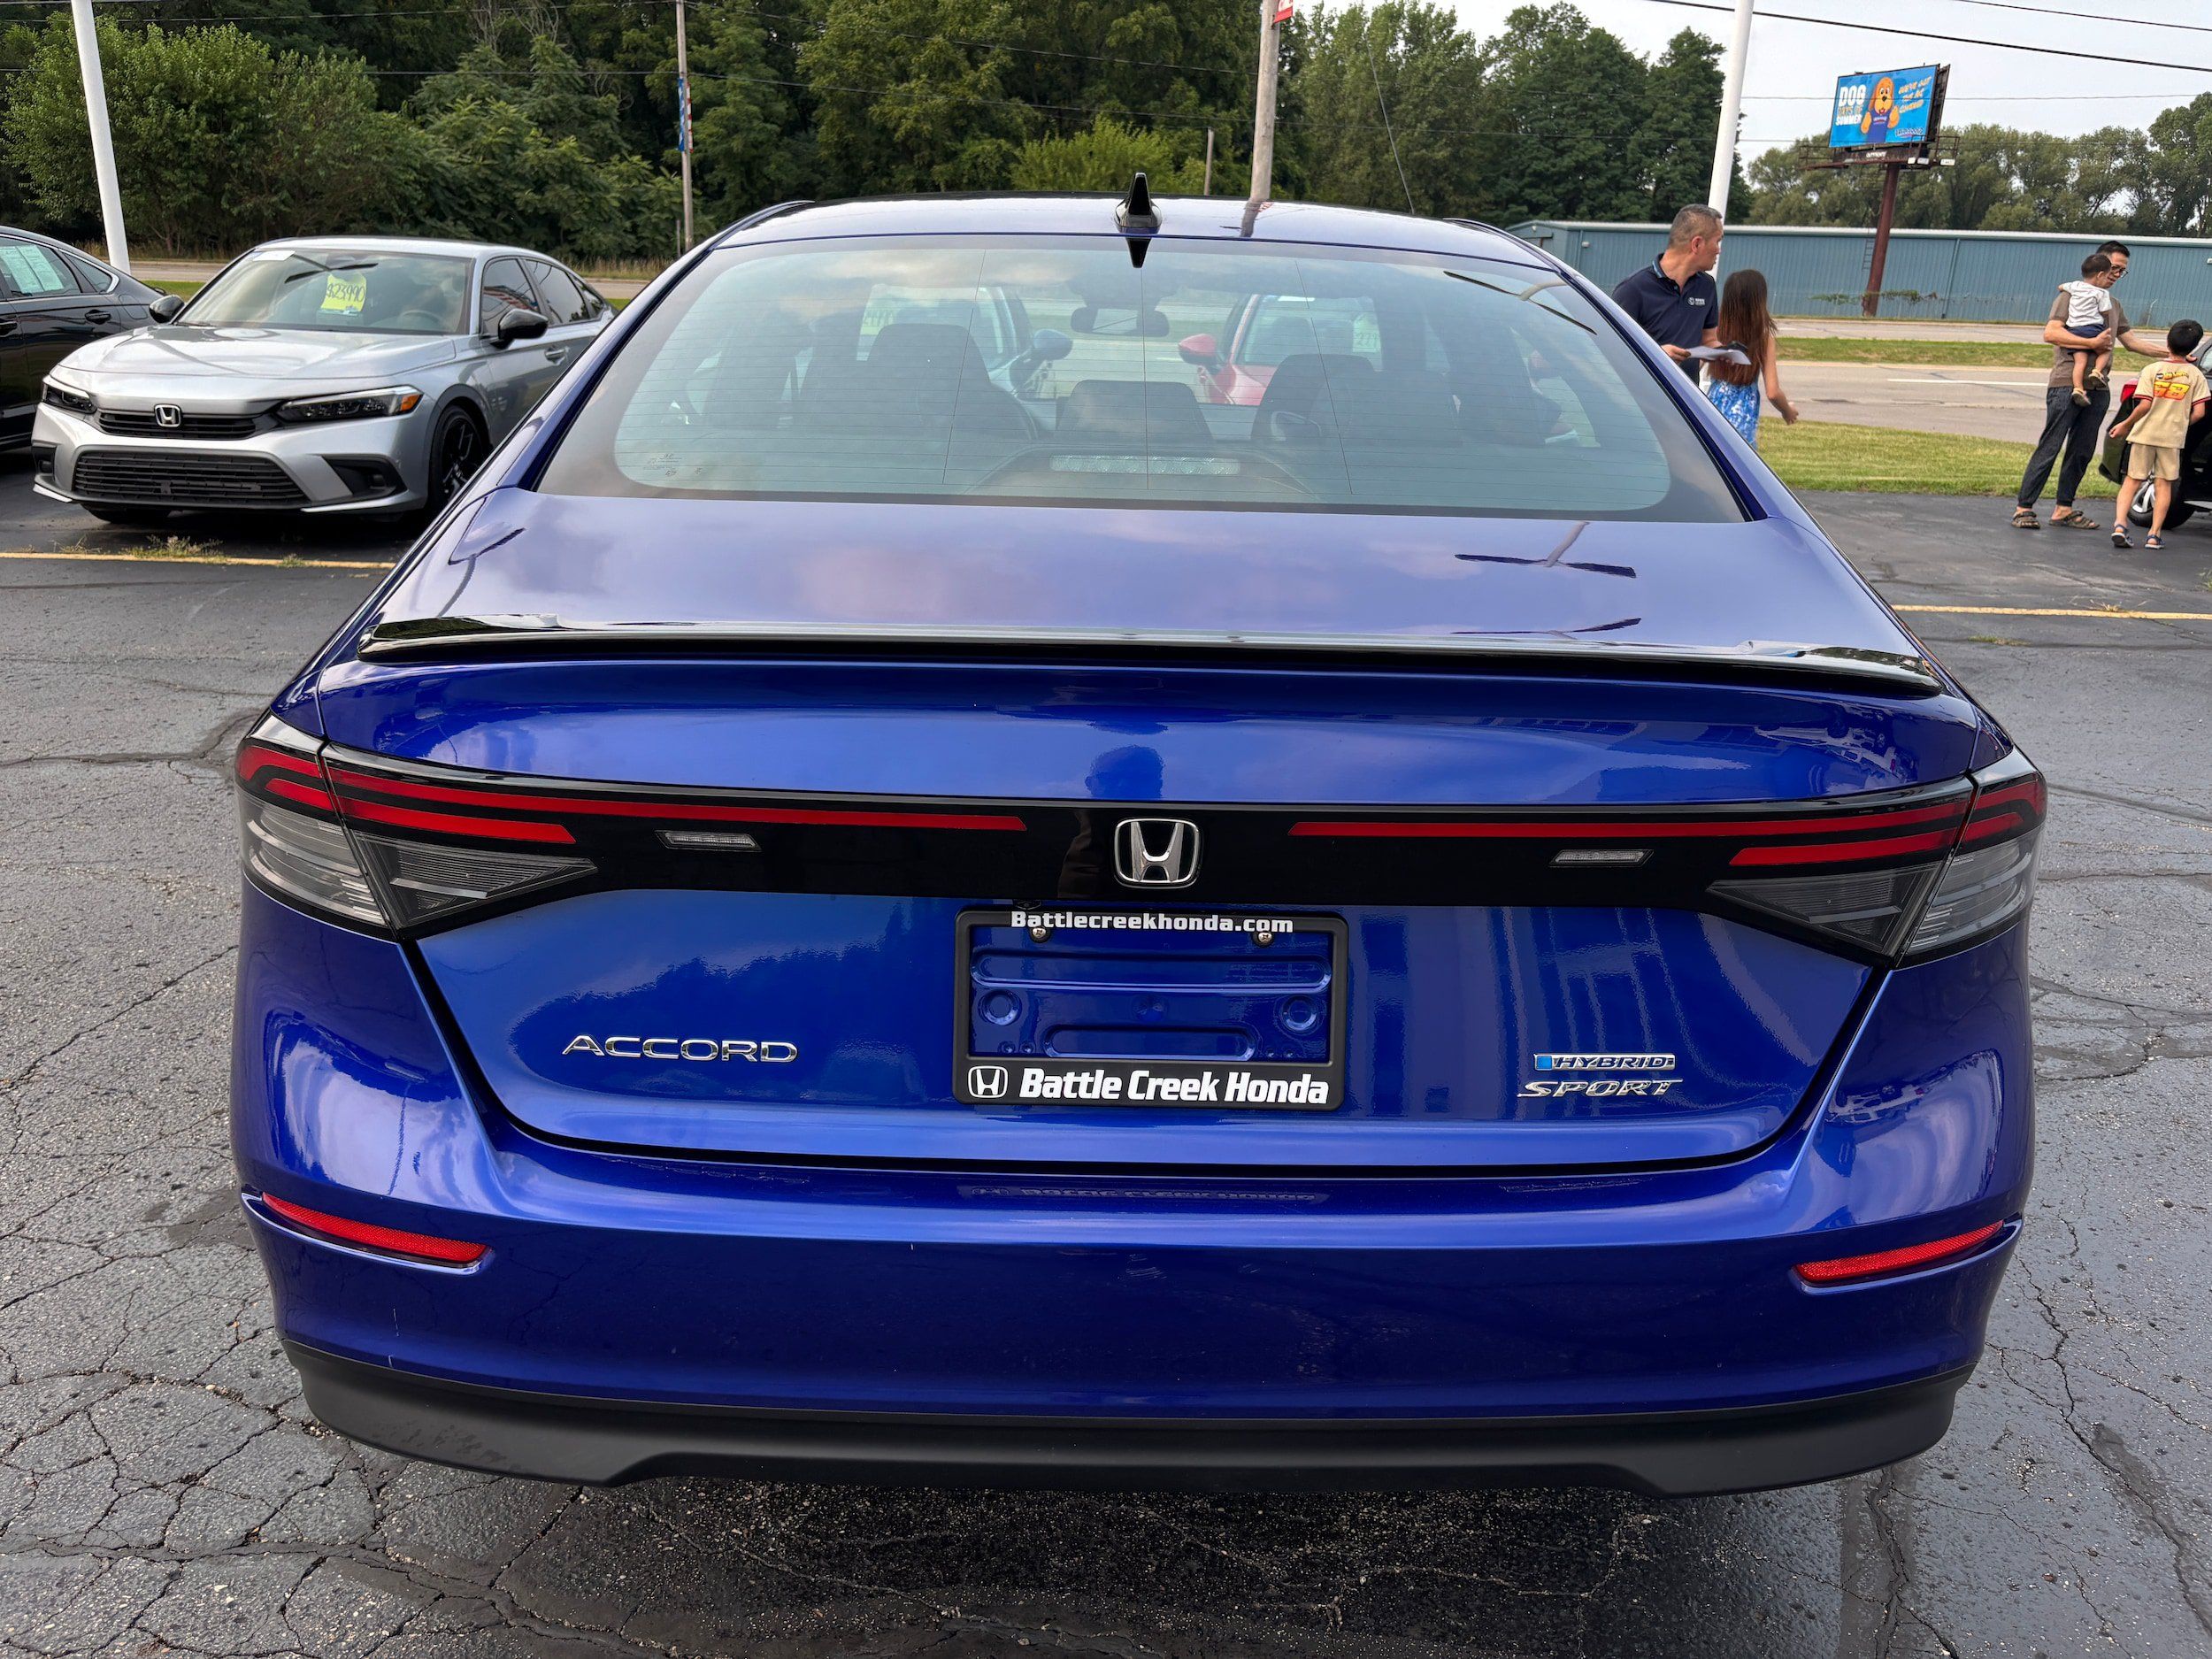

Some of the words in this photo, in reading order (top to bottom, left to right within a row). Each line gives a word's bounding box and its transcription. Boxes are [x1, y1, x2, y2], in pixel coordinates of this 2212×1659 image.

[1839, 84, 1867, 106] DOG
[1010, 910, 1294, 933] Battlecreekhonda.com
[562, 1033, 798, 1063] ACCORD
[1555, 1056, 1669, 1070] HYBRID
[1019, 1068, 1122, 1101] Battle
[1127, 1070, 1221, 1102] Creek
[1224, 1071, 1329, 1104] Honda
[1517, 1078, 1684, 1098] SPORT
